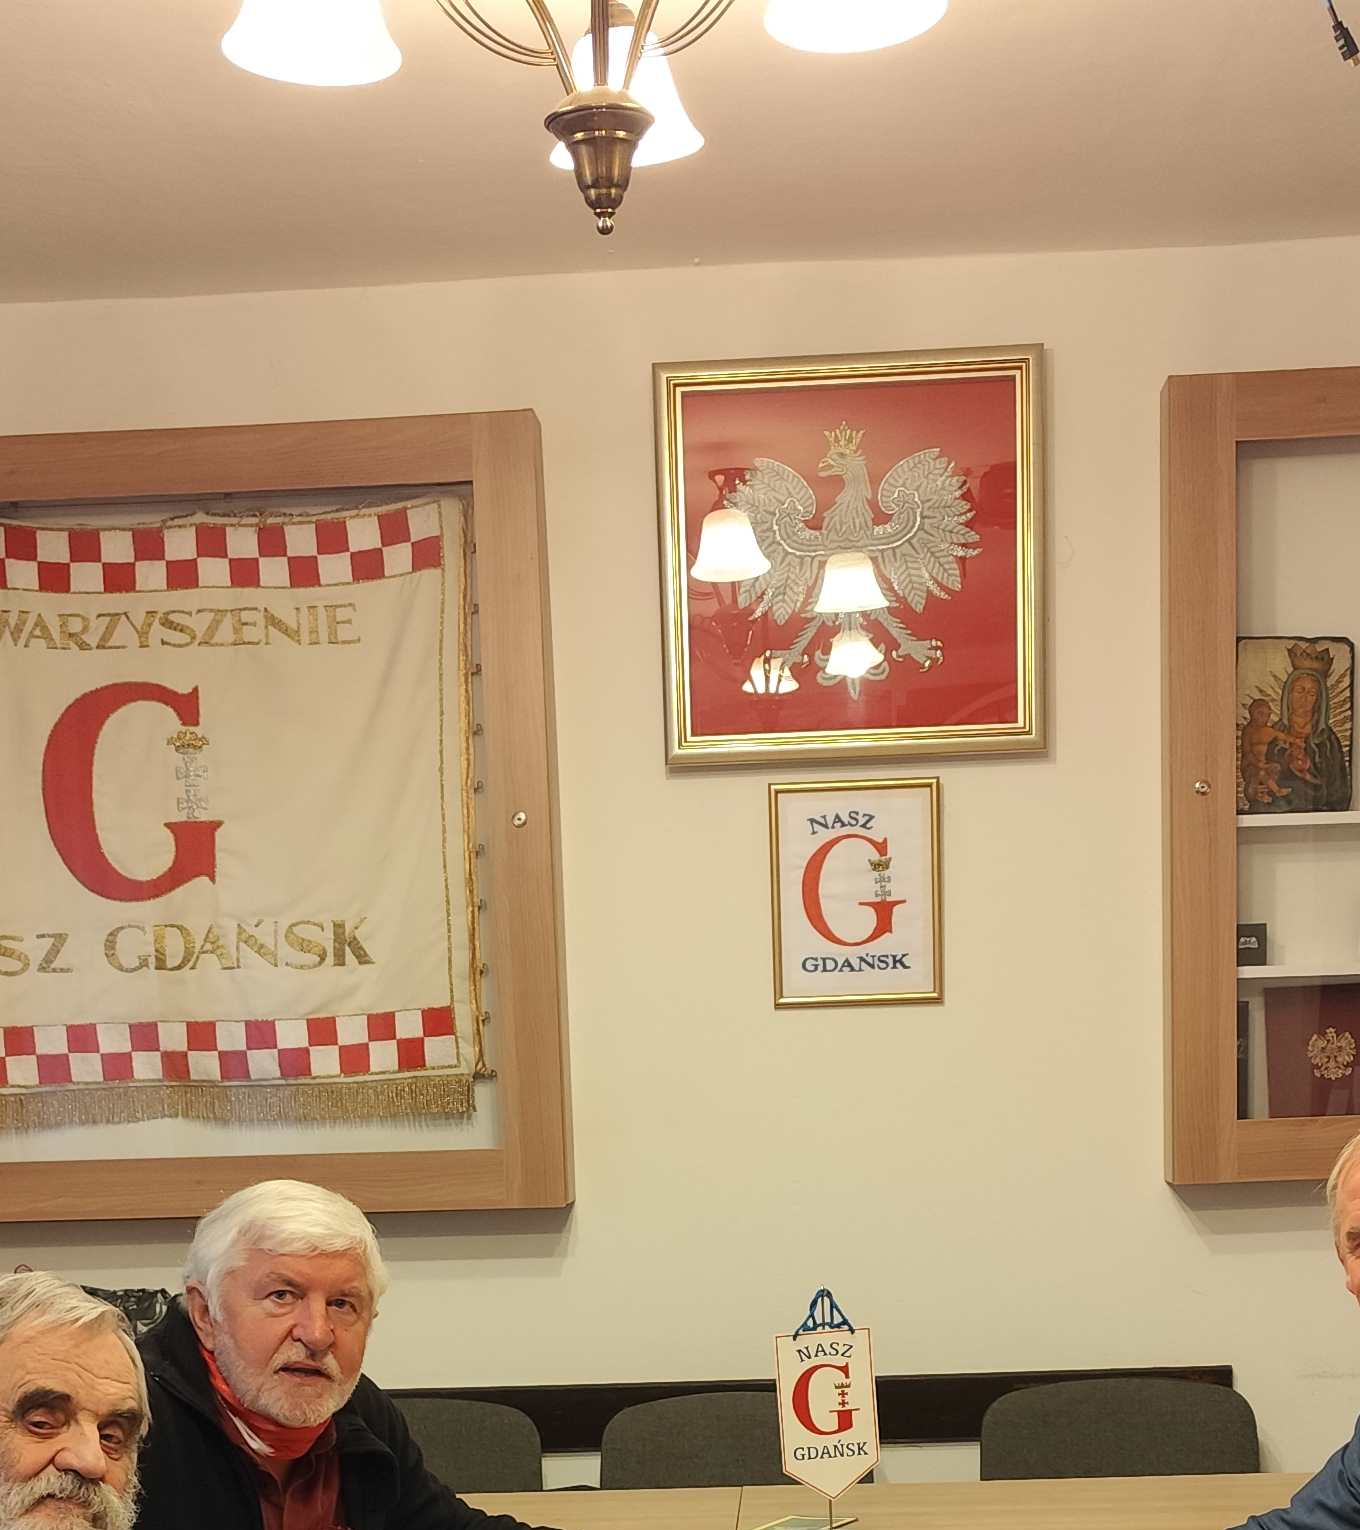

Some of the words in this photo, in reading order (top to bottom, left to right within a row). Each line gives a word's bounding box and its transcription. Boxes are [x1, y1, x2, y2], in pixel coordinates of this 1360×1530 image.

[42, 681, 224, 903] G
[807, 811, 875, 835] NASZ
[802, 834, 907, 946] G
[103, 916, 375, 972] GDAŃSK
[802, 953, 911, 972] GDAŃSK
[796, 1342, 853, 1362] NASZ
[792, 1362, 860, 1435] G
[794, 1440, 868, 1460] GDAŃSK
